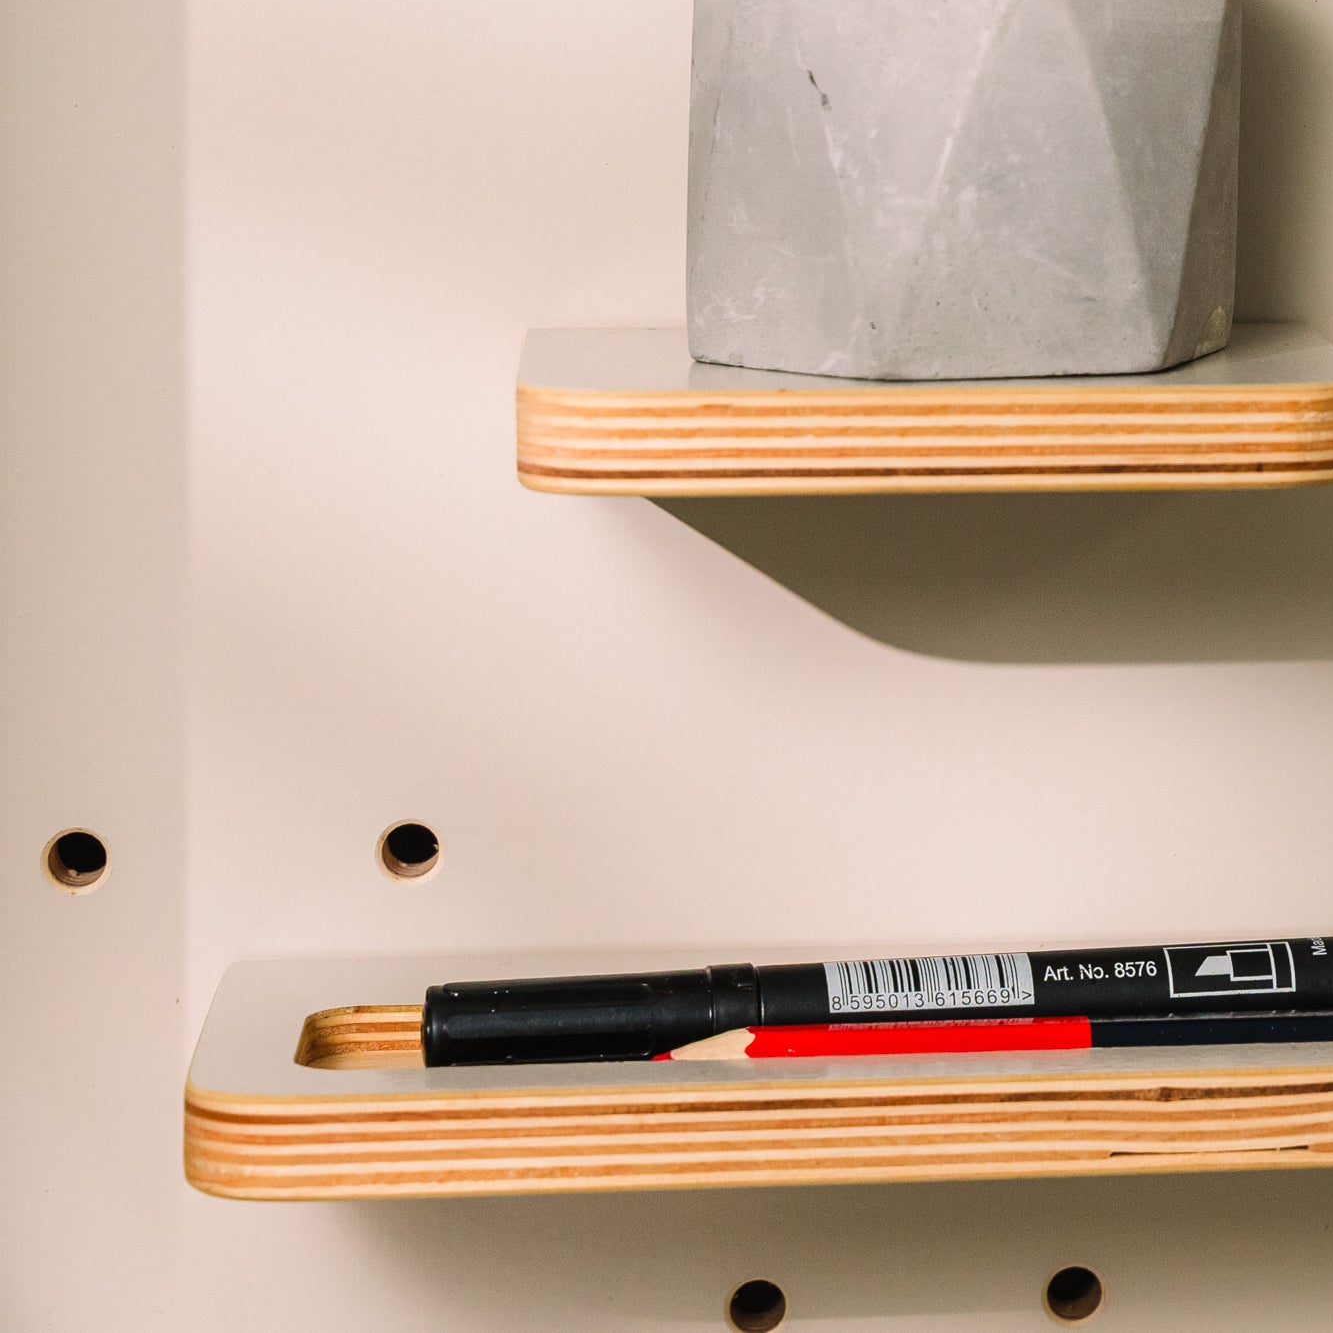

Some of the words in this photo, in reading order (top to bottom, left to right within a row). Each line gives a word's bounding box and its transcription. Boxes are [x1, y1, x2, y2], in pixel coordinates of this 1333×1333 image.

[1043, 965, 1074, 982] Art.
[1079, 963, 1110, 981] No.
[1114, 960, 1158, 979] 8576
